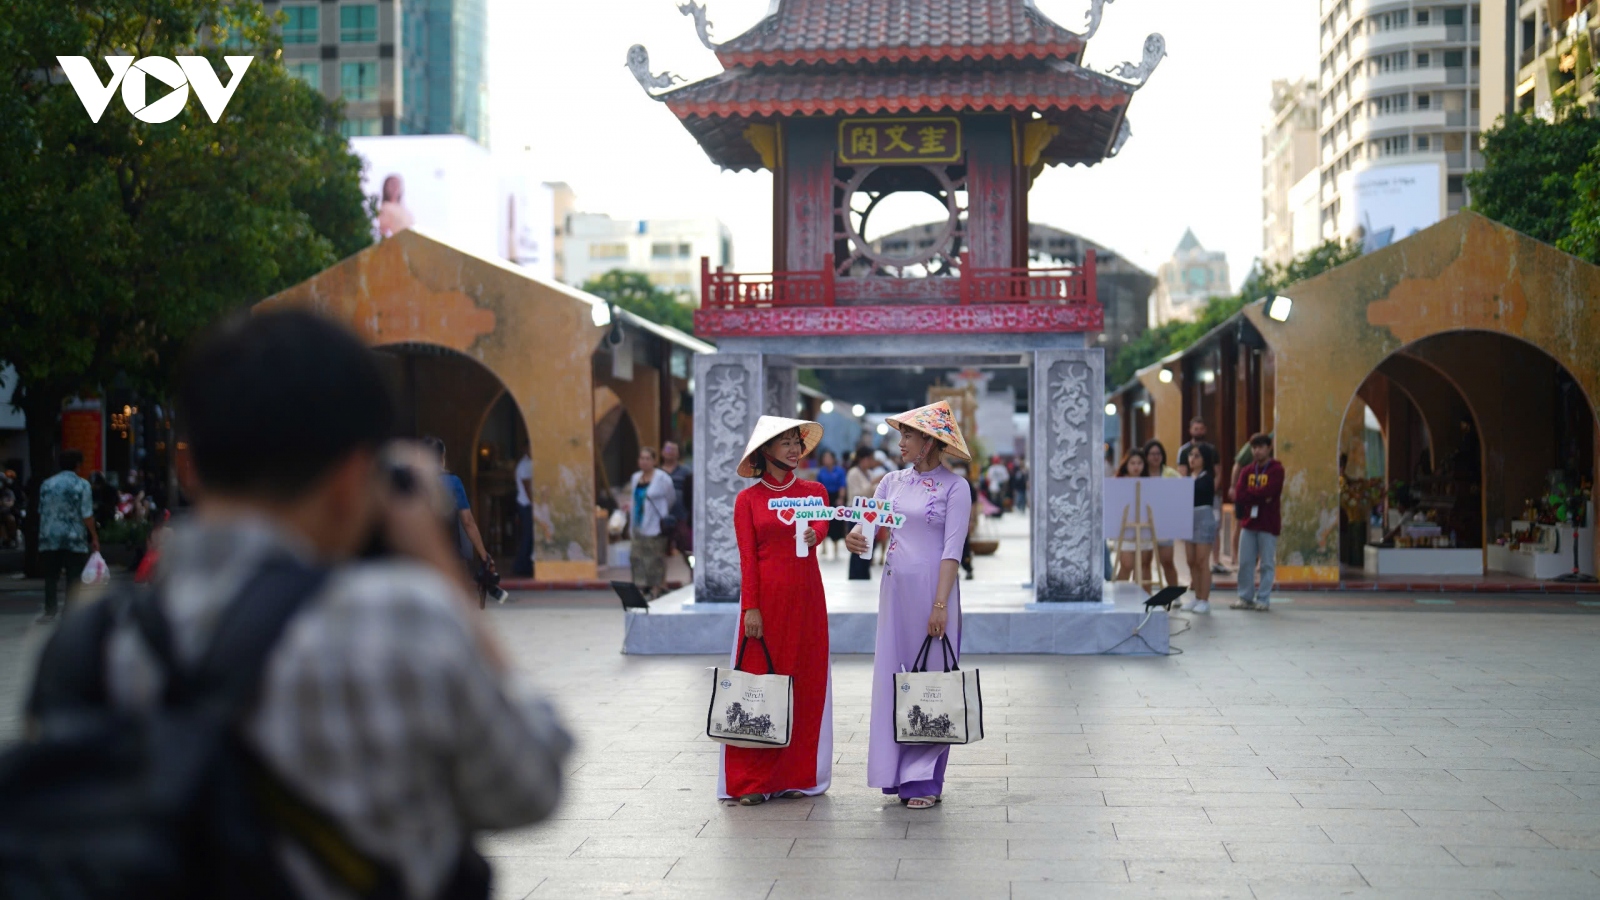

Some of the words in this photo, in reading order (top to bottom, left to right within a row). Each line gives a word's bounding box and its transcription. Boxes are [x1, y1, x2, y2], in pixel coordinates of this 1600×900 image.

[803, 497, 823, 507] LÂM
[855, 498, 860, 507] I
[862, 499, 891, 511] LOVE
[796, 510, 814, 519] SƠN
[816, 508, 833, 518] TÂY
[837, 508, 861, 520] SƠN
[880, 513, 903, 526] TÂY
